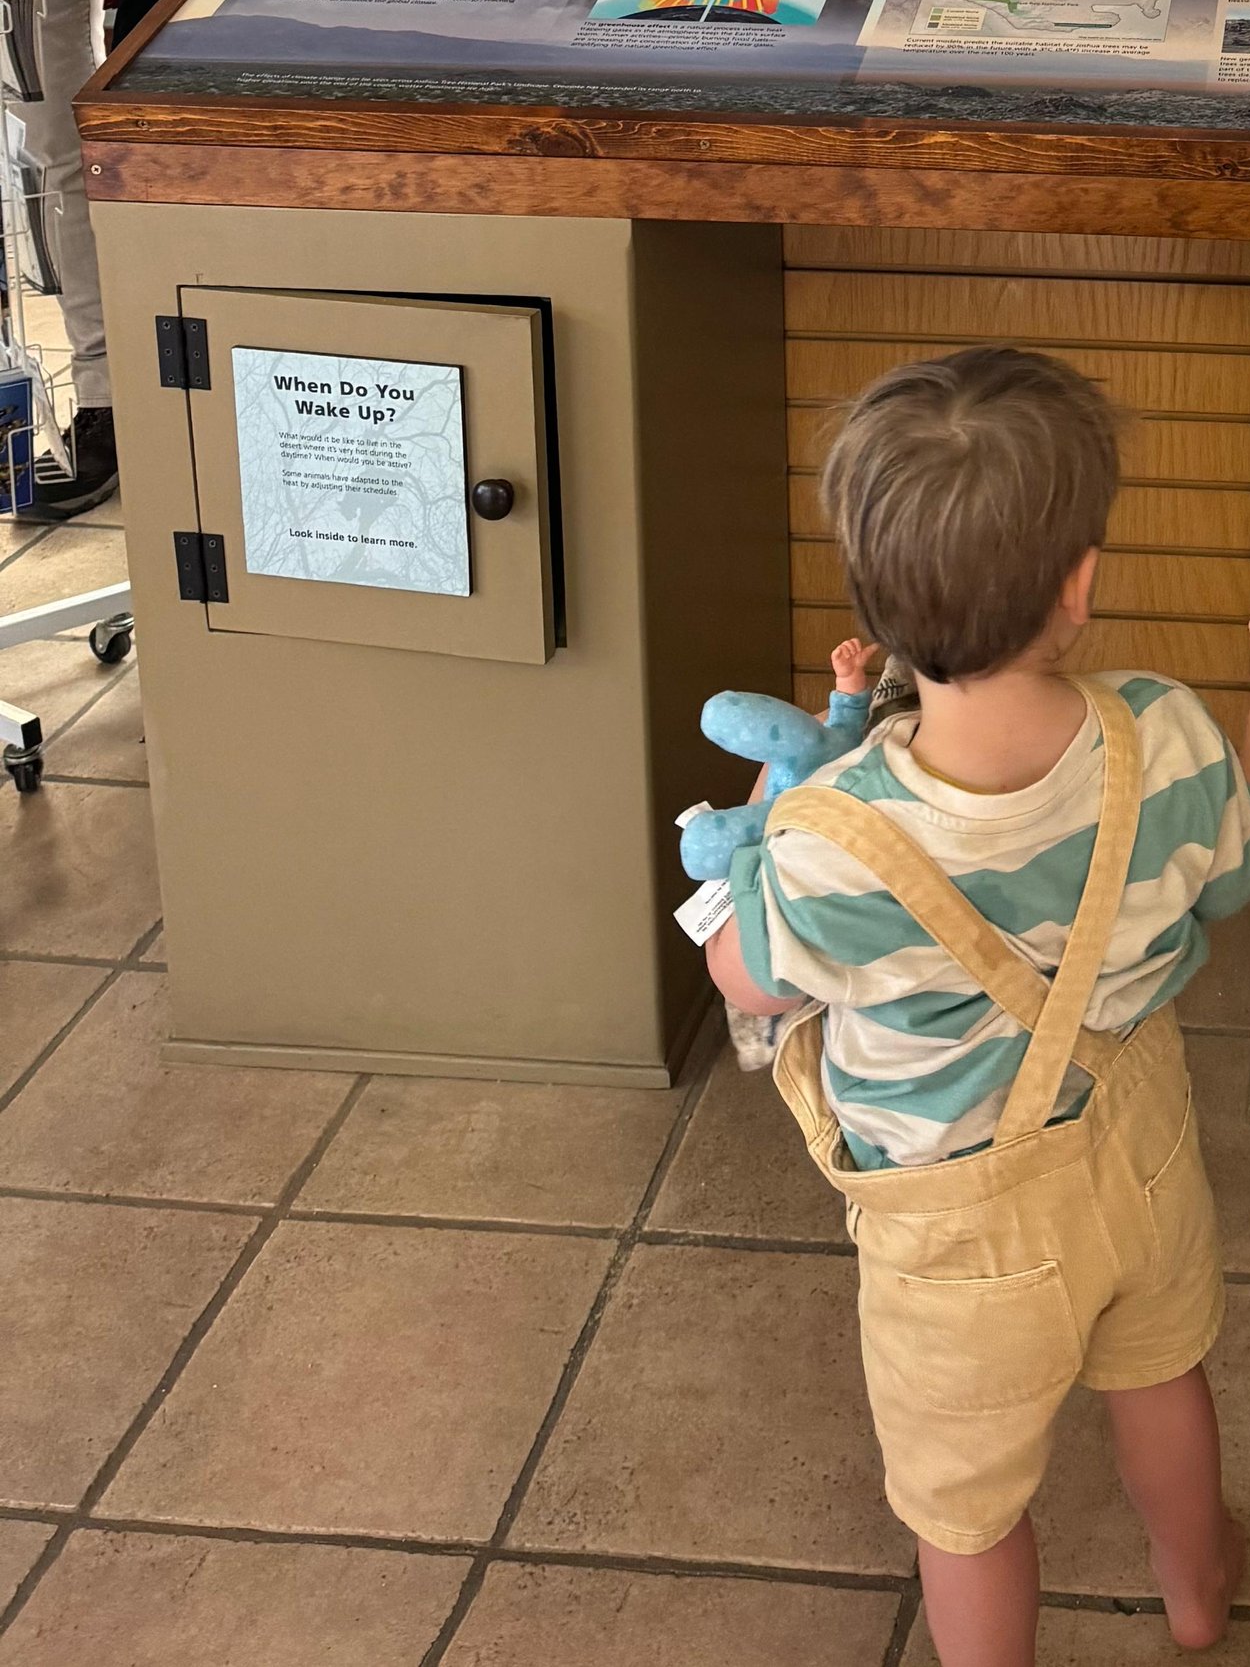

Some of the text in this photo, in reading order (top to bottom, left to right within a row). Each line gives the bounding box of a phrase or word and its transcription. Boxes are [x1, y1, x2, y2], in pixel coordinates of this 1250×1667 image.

[273, 375, 414, 401] When Do You
[294, 399, 396, 425] Wake Up?
[289, 527, 417, 548] Look inside to learn more.
